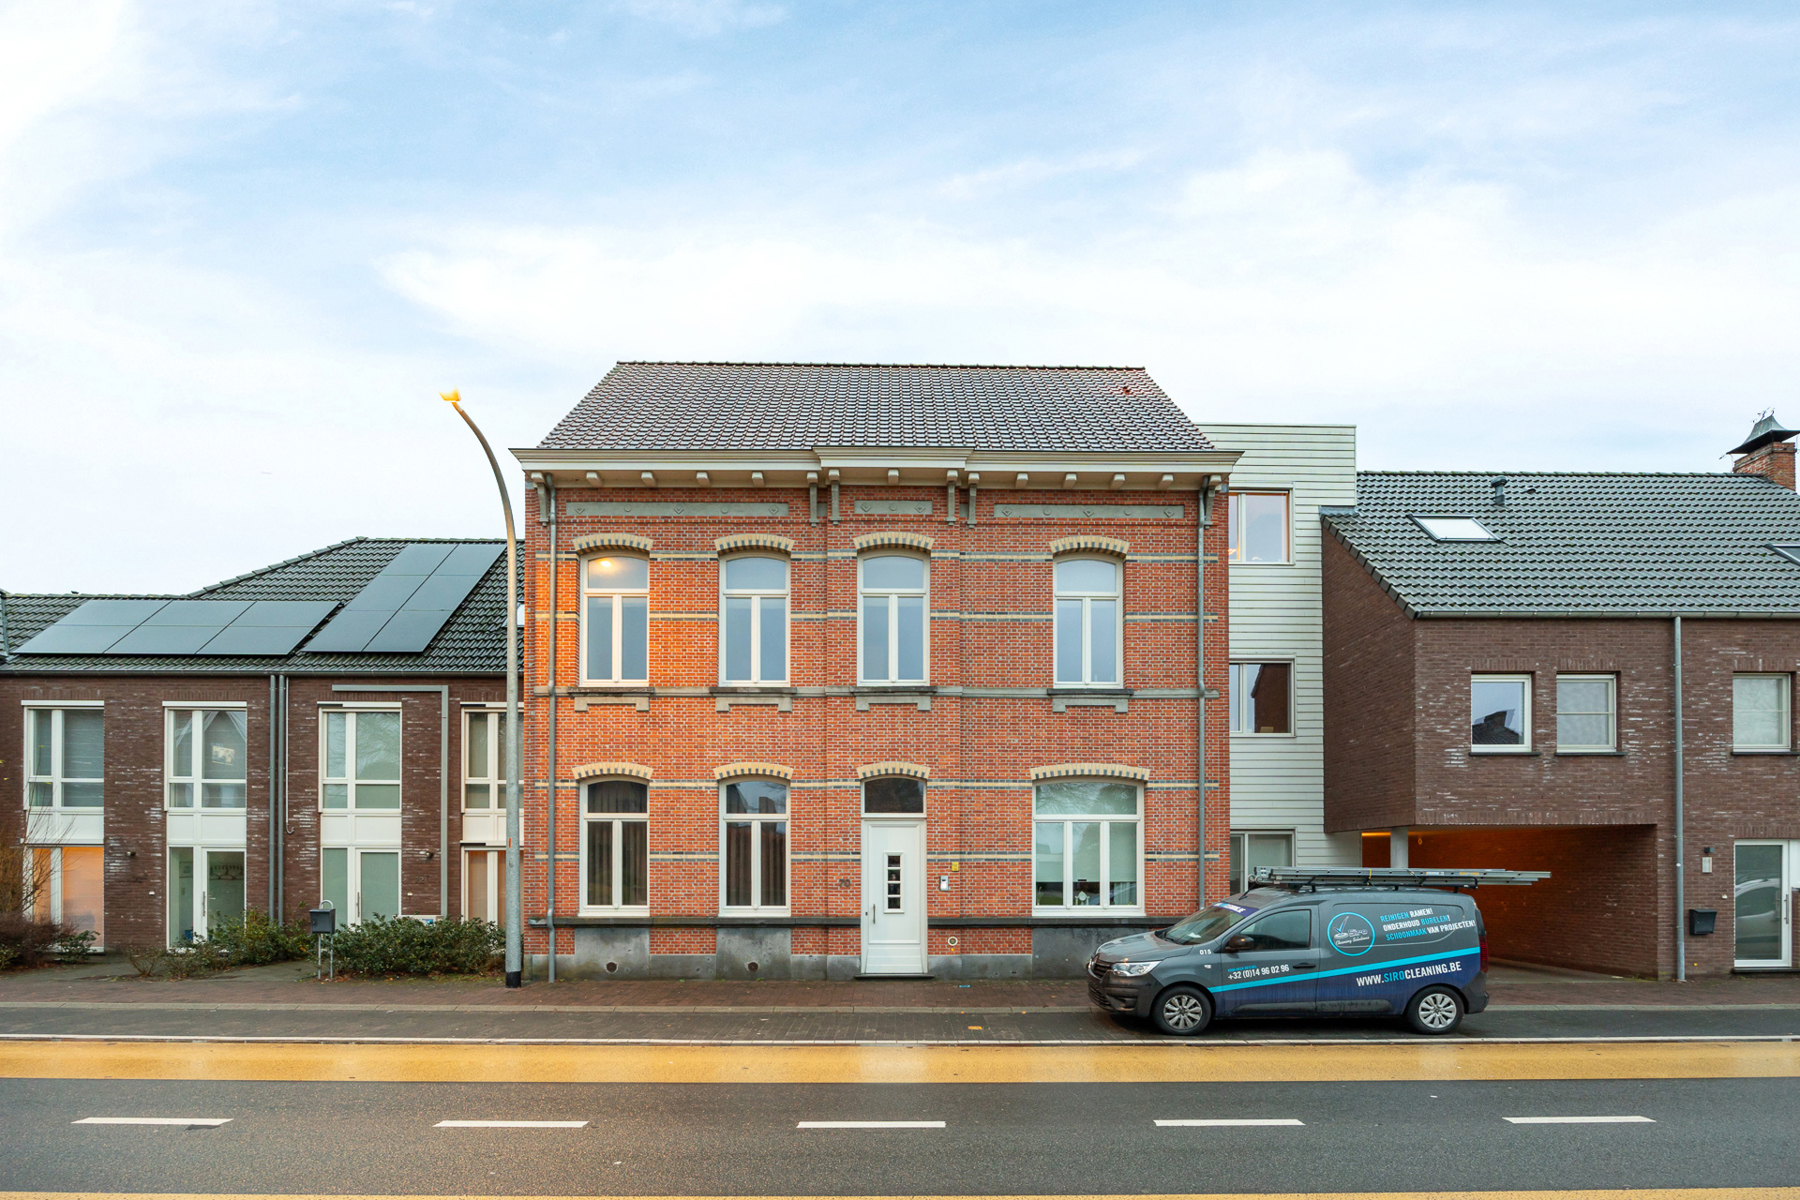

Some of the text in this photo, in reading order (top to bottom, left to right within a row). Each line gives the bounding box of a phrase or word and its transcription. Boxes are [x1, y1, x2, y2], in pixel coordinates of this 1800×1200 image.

[839, 879, 851, 887] 70
[1380, 908, 1433, 922] REINIGEN RAMEN!
[1383, 915, 1450, 931] ONDERHOUD BURELEN!
[1386, 920, 1476, 940] SCHOONMAAK VAN PROJECTEN!
[1228, 971, 1242, 979] +32
[1242, 968, 1261, 979] (0)14
[1261, 966, 1271, 975] 96
[1270, 965, 1280, 974] 02
[1280, 963, 1290, 973] 96
[1356, 962, 1462, 986] WWW.SIROCLEANING.BE
